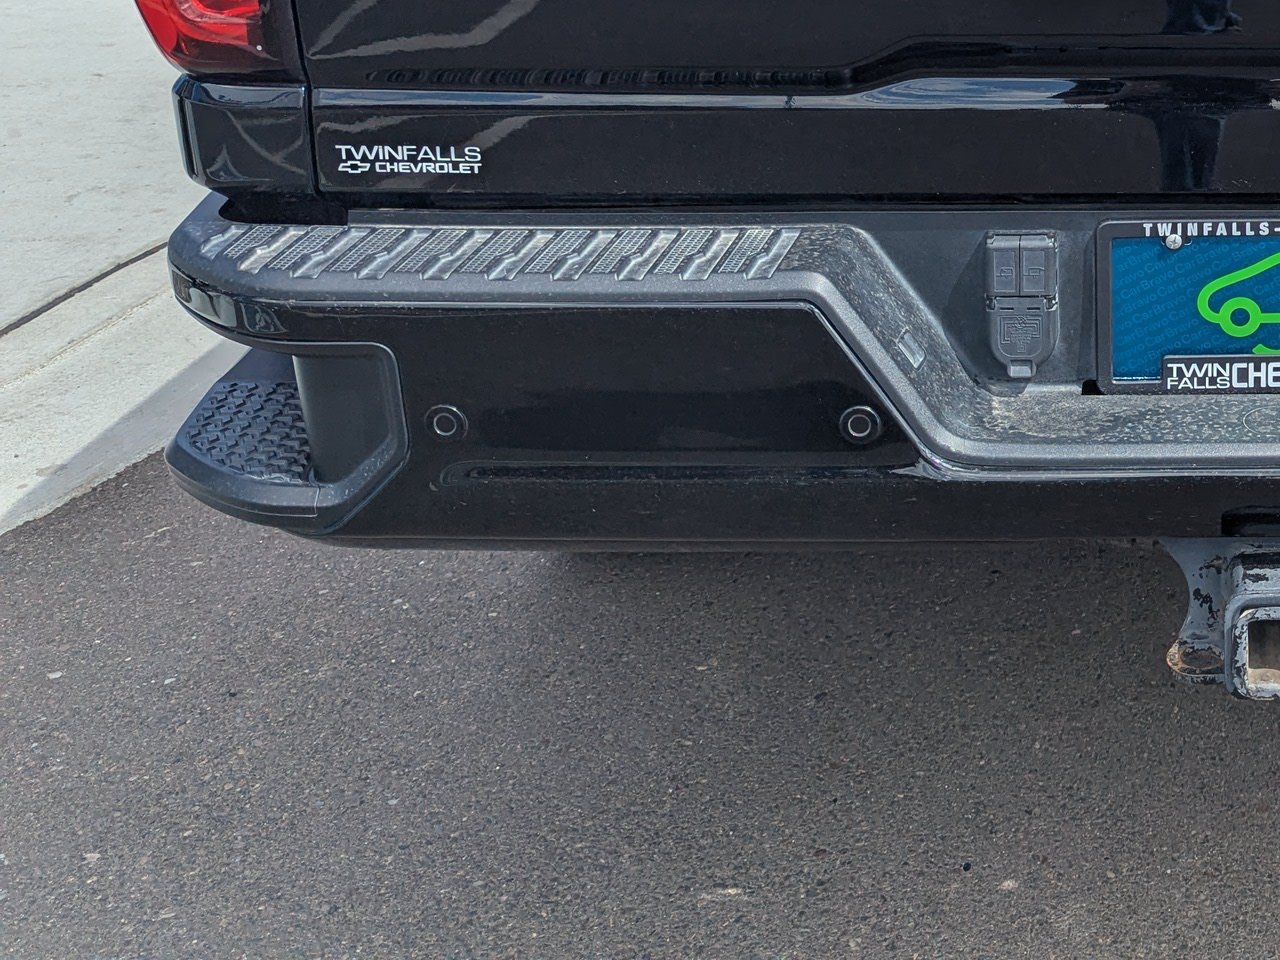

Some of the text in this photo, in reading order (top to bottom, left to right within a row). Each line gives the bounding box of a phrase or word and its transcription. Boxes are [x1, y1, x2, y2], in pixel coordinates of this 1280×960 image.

[335, 145, 482, 161] TWINFALLS
[375, 162, 482, 174] CHEVROLET
[1167, 362, 1230, 377] TWIN
[1167, 377, 1230, 389] FALLS
